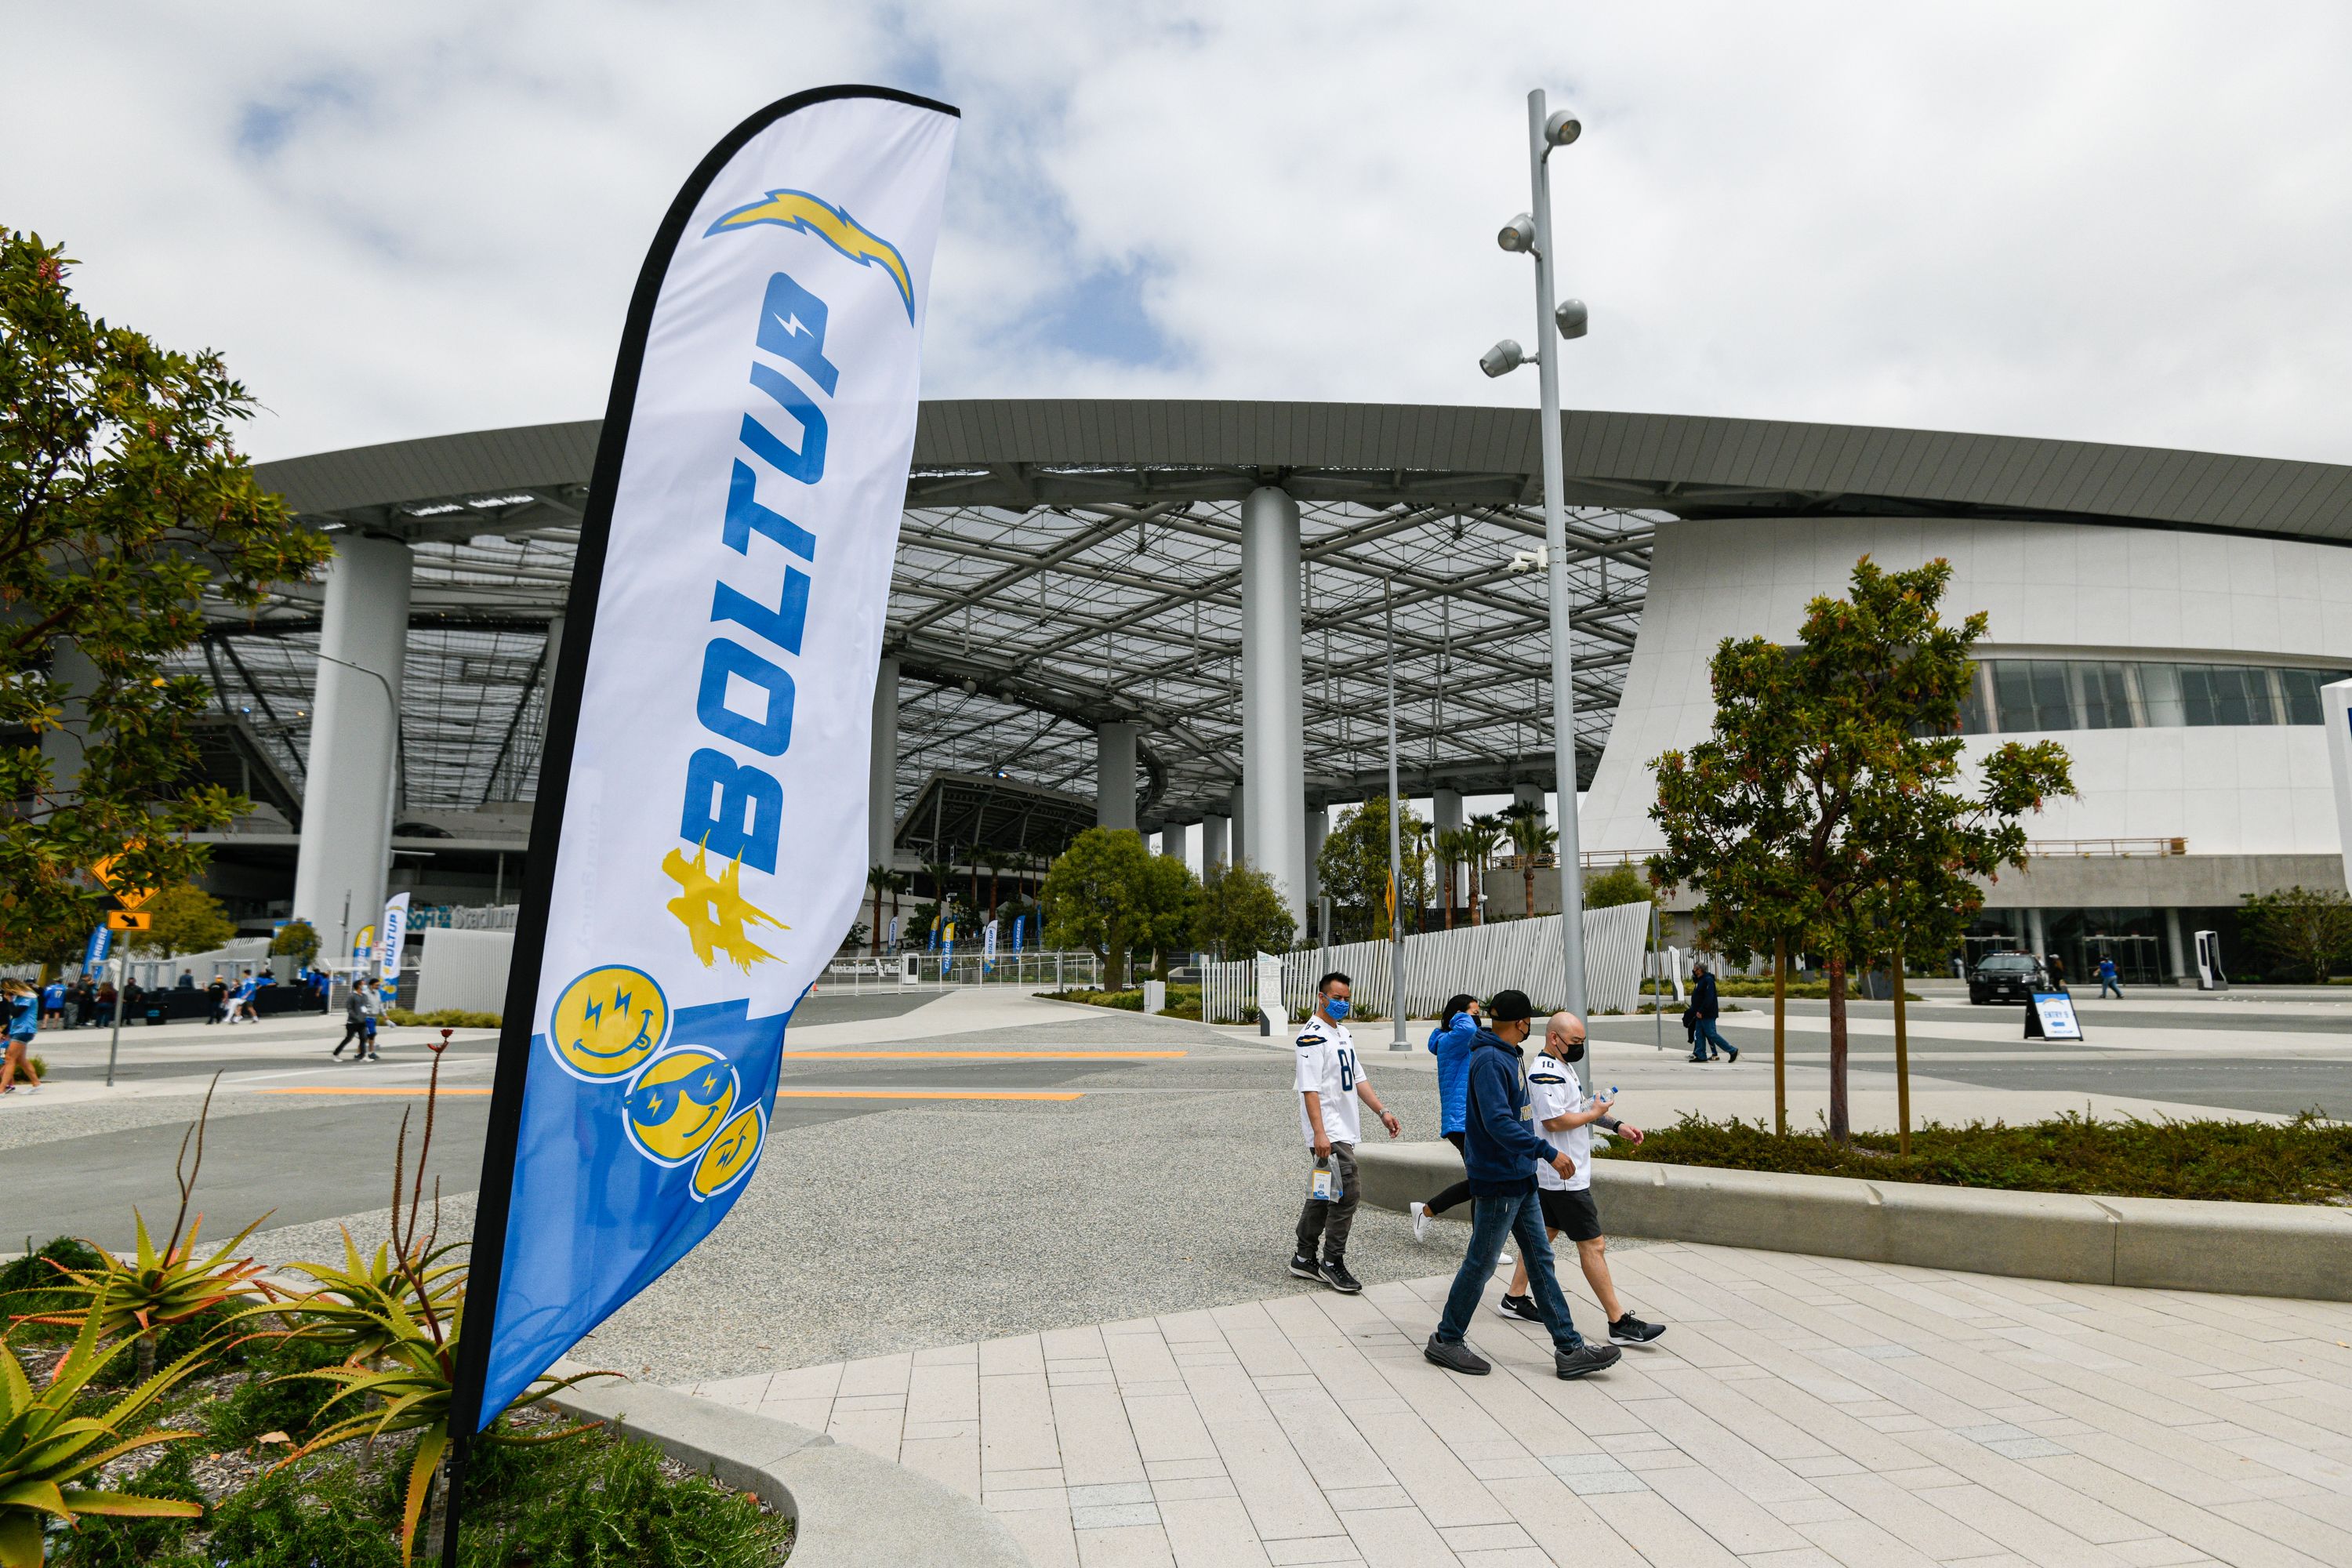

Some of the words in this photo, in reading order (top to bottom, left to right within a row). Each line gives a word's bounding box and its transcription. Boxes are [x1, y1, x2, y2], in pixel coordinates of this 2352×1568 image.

[662, 271, 840, 976] #BOLTUP
[406, 906, 437, 930] SoFi
[453, 903, 517, 929] Stadium
[1305, 1022, 1321, 1031] 84
